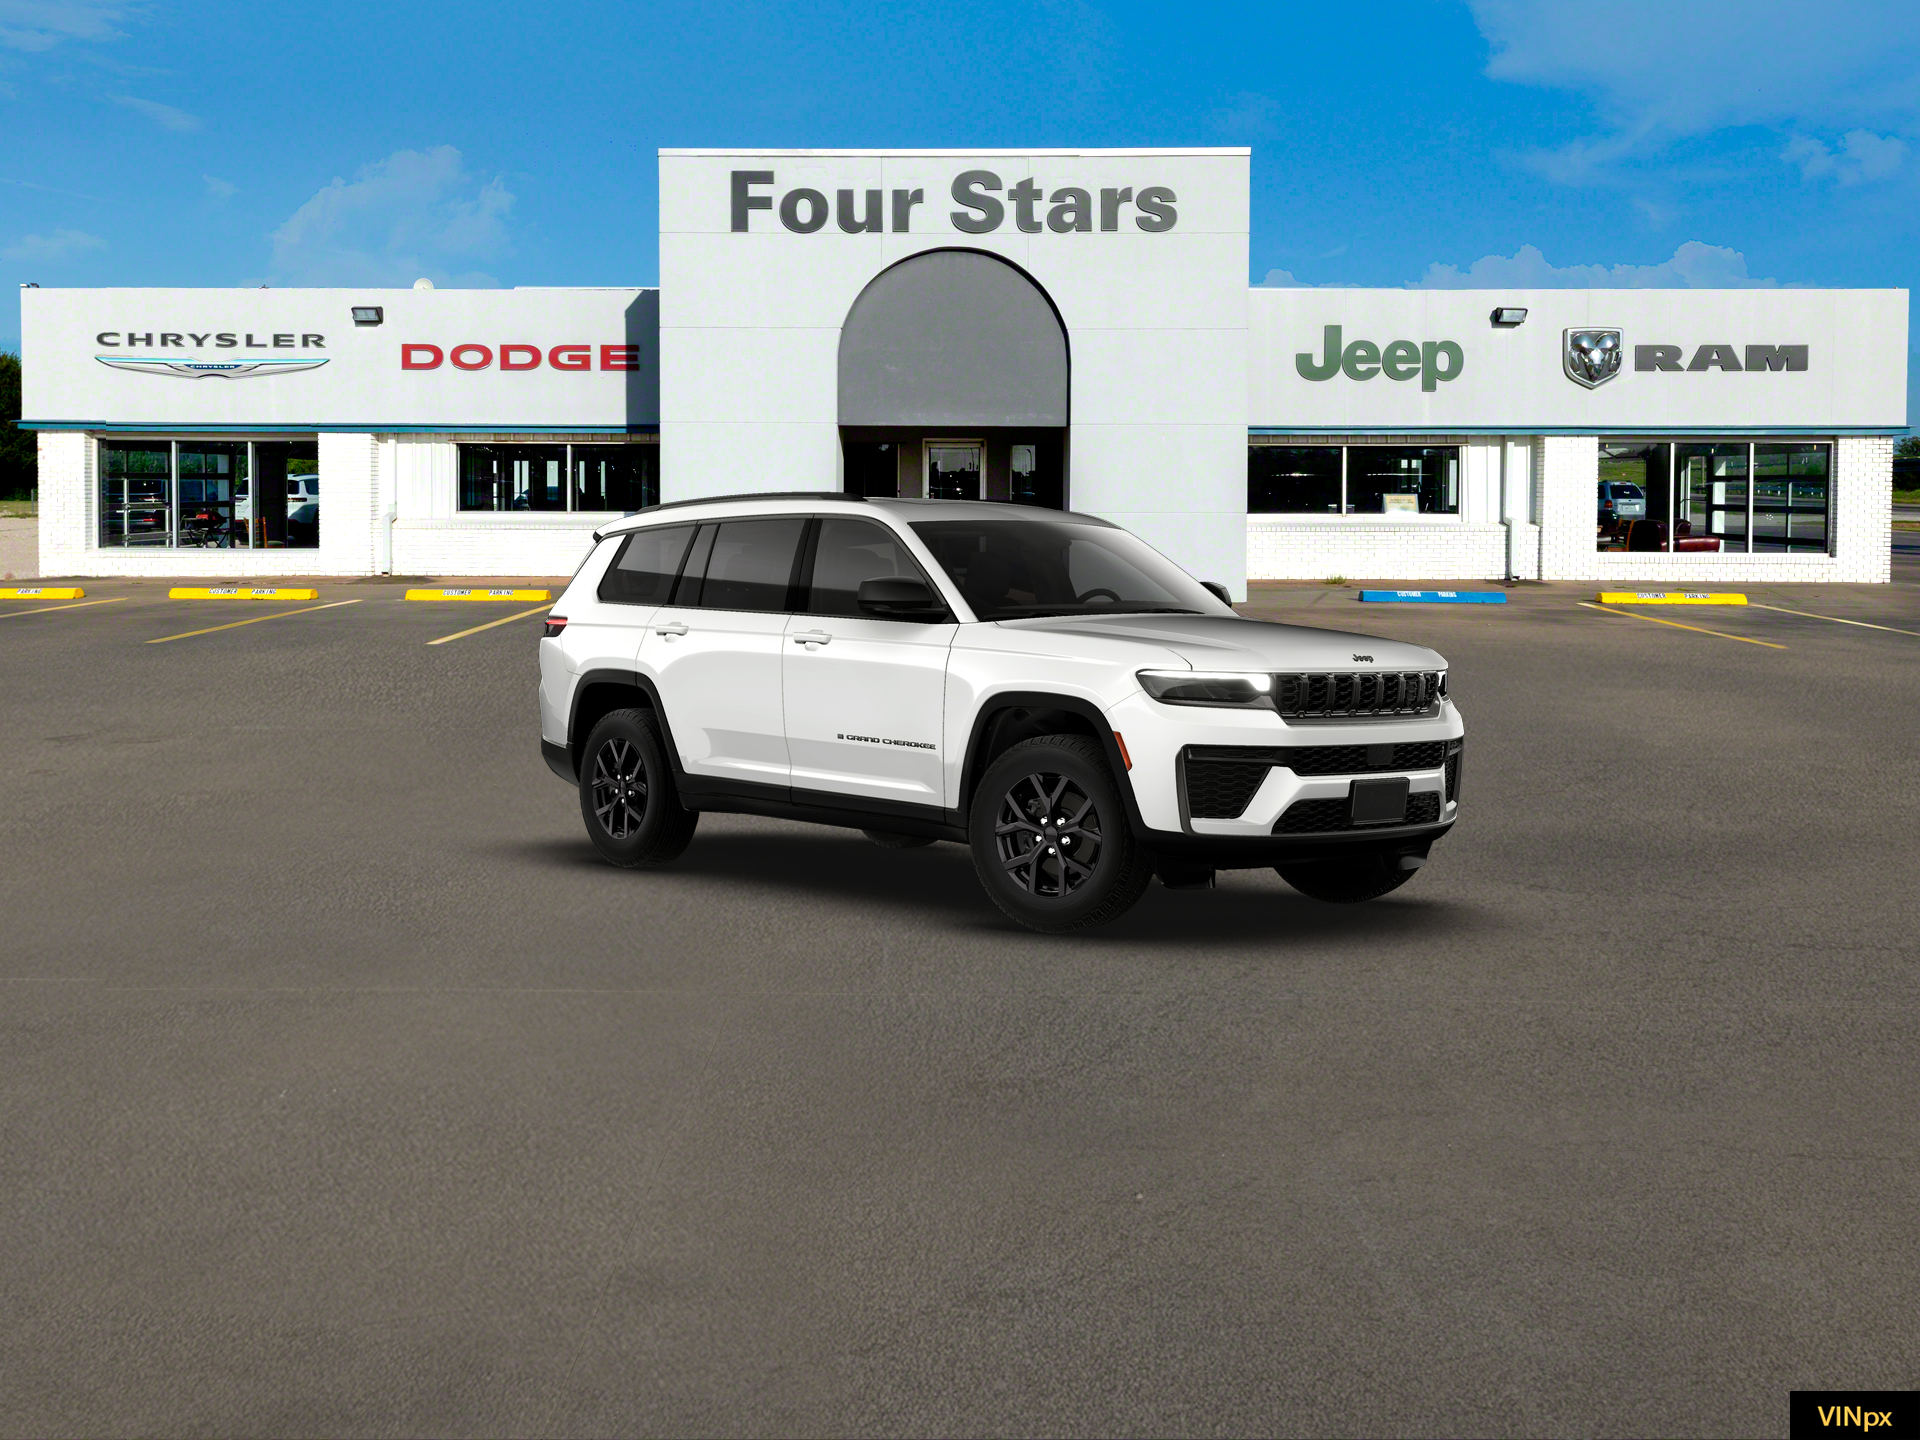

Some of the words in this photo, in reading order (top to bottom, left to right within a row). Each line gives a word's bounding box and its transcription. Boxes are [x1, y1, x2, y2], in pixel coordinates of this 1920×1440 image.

[731, 170, 924, 234] Four
[950, 169, 1178, 233] Stars
[96, 332, 326, 348] CHRYSLER
[401, 343, 640, 371] DODGE
[1295, 325, 1464, 392] Jeep
[1634, 344, 1809, 372] RAM
[1352, 653, 1374, 663] Jeep
[846, 734, 880, 743] GRAND
[882, 738, 936, 750] CHEROKEE
